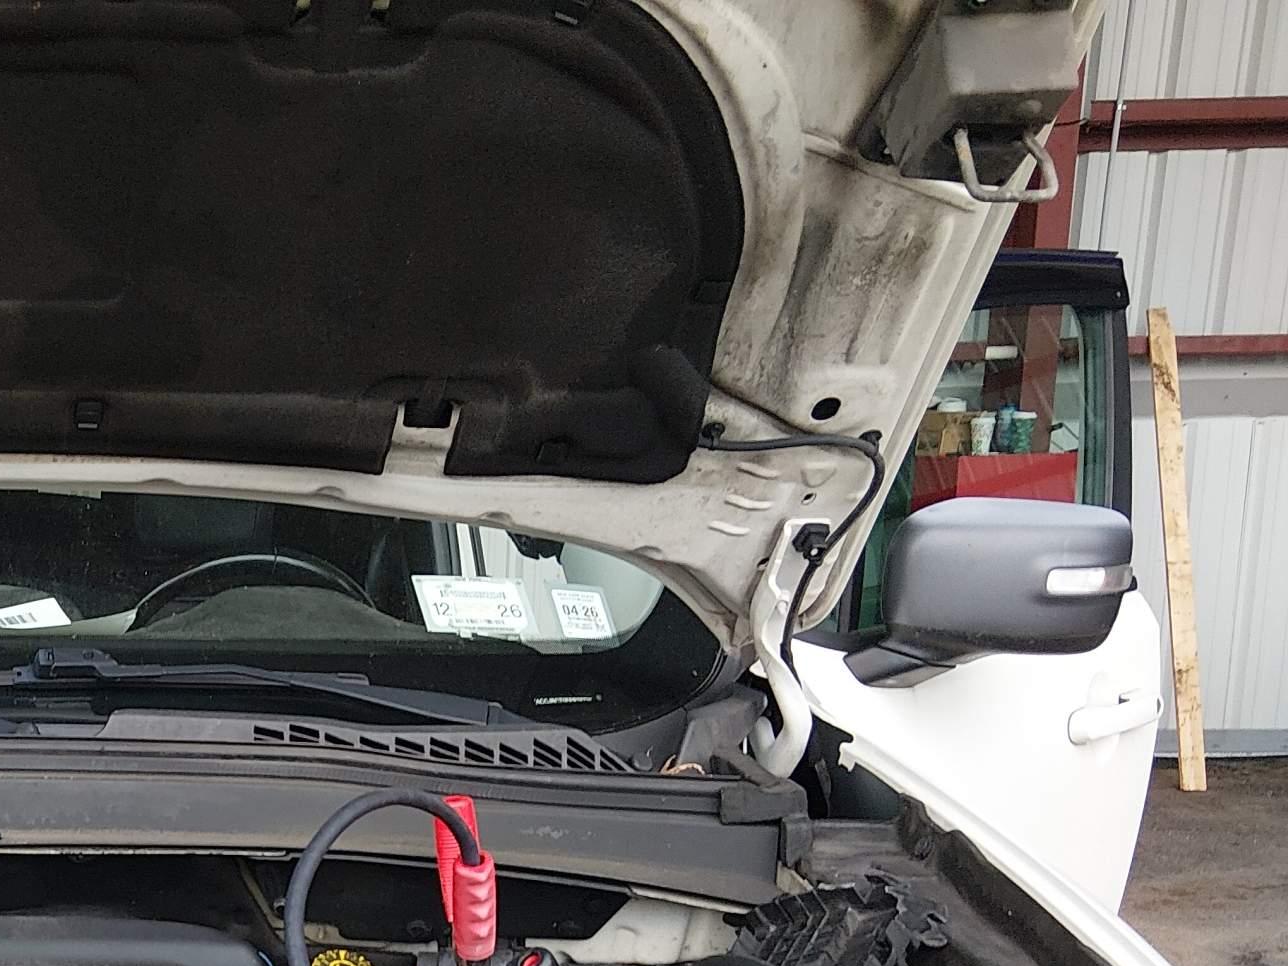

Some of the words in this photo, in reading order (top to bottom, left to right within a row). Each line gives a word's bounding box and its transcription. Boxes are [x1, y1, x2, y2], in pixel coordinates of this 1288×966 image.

[433, 602, 450, 617] 12
[497, 604, 522, 618] 26
[582, 605, 599, 618] 26
